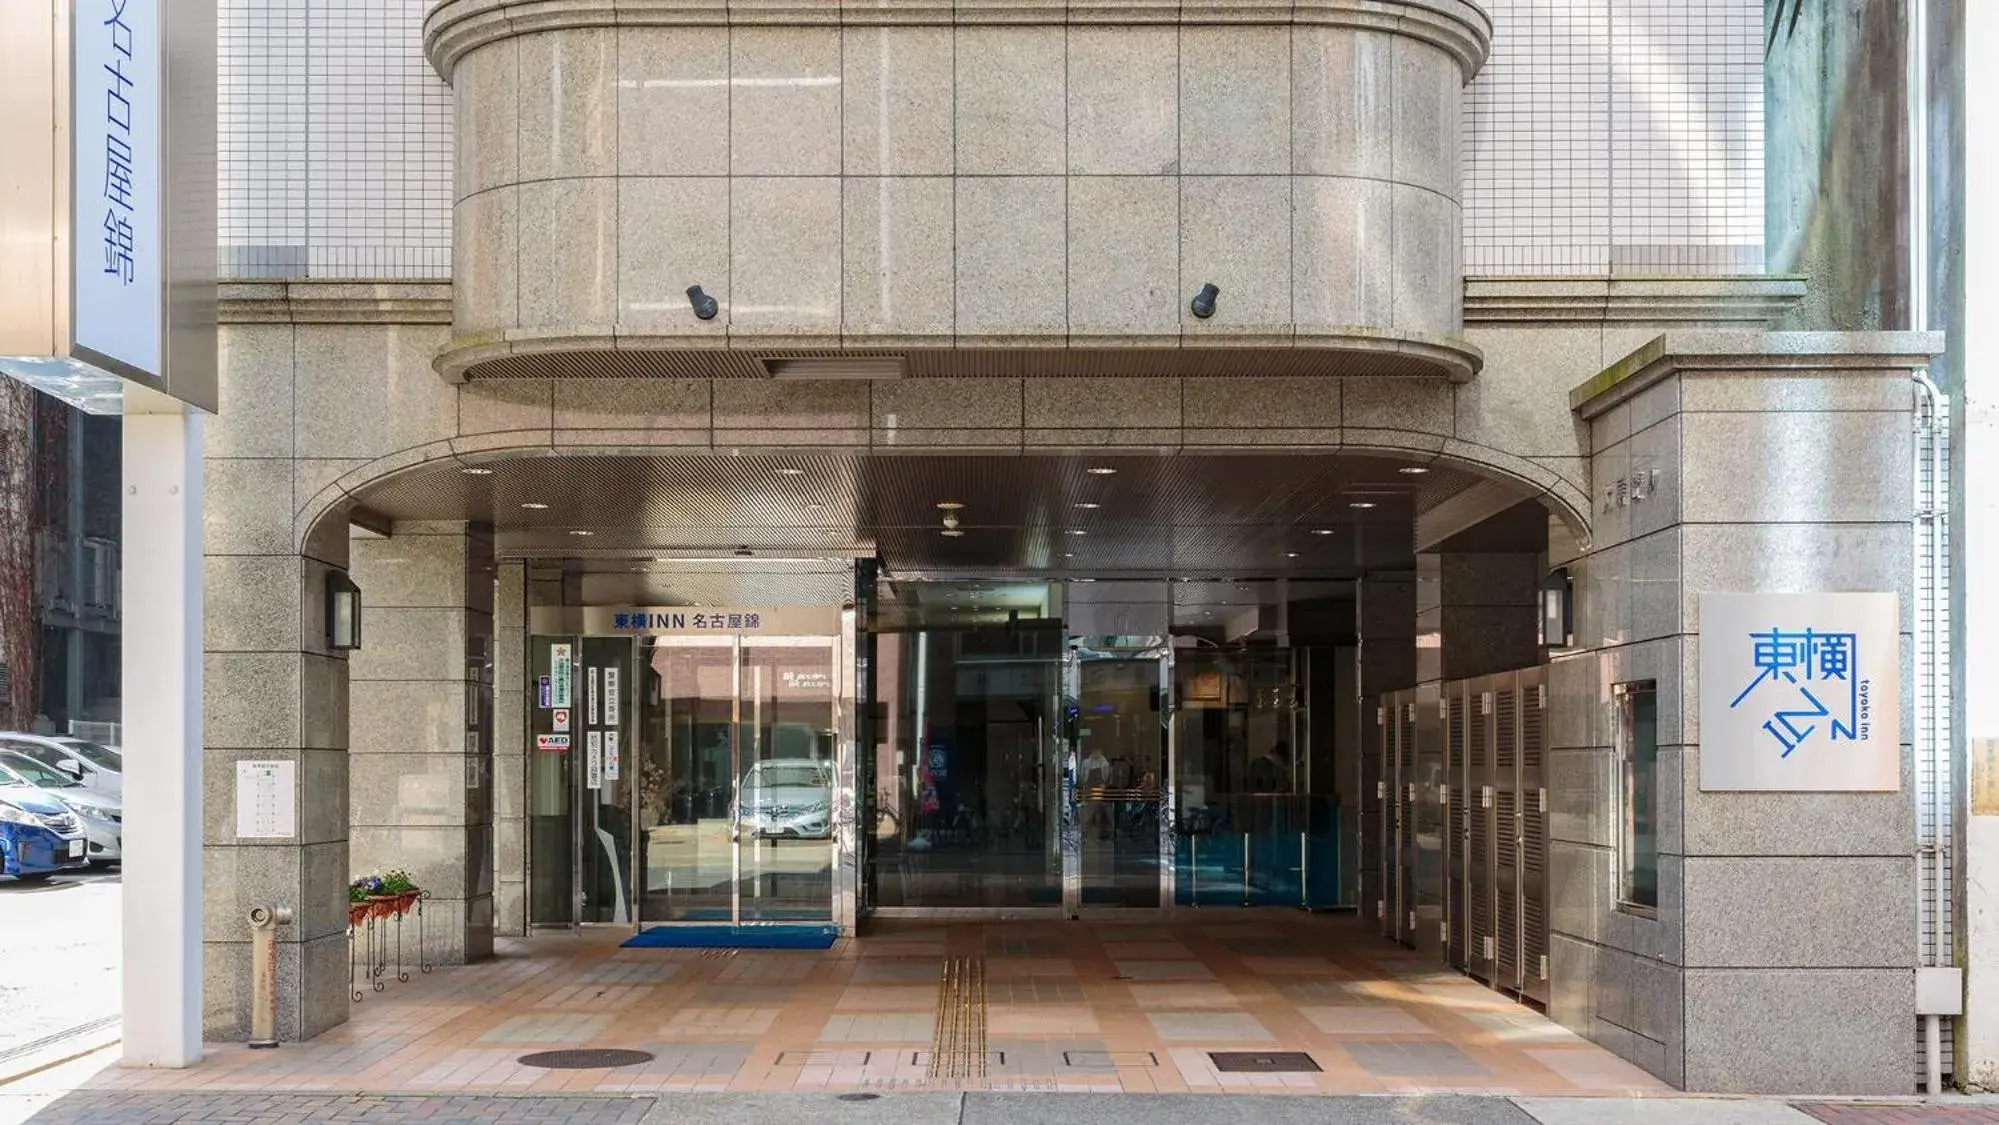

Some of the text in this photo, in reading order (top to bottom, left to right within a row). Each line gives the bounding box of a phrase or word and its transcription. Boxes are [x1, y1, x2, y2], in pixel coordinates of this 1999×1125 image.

[613, 613, 760, 629] 東横INN 名古屋錦
[1859, 679, 1871, 741] toyoko inn
